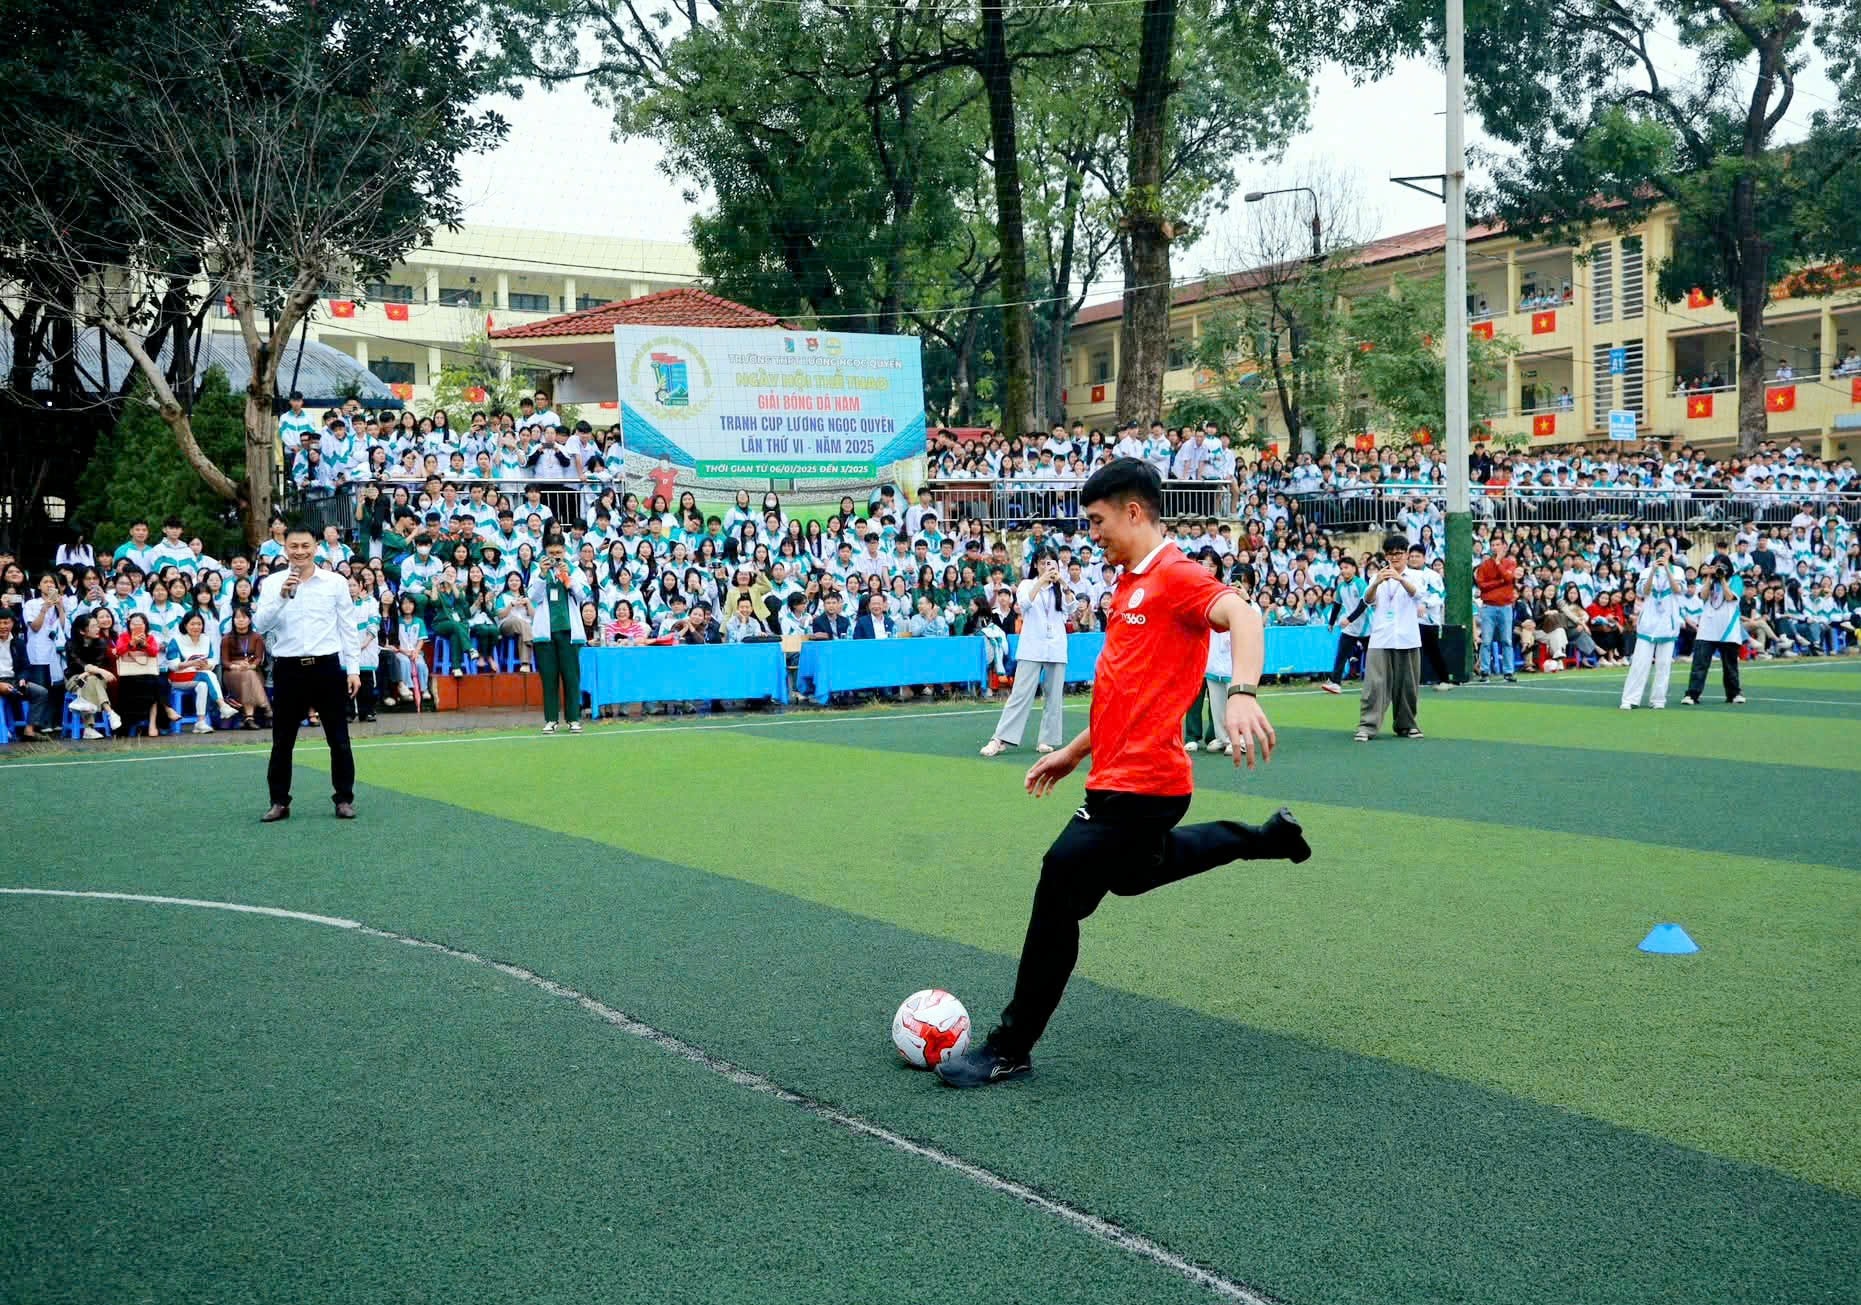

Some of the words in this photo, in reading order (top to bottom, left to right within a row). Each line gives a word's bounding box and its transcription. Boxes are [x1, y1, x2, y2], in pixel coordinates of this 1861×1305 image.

[758, 390, 779, 410] GIẢI
[784, 391, 813, 410] BÓNG
[835, 396, 861, 412] NAM
[720, 415, 758, 431] TRANH
[761, 416, 783, 431] CUP
[787, 415, 825, 433] LƯƠNG
[828, 417, 857, 436] NGỌC
[766, 435, 789, 453] THỨ
[793, 438, 804, 454] VI
[816, 435, 842, 454] NĂM
[845, 439, 875, 454] 2025
[706, 463, 728, 473] THỜI
[731, 465, 753, 473] GIAN
[756, 463, 768, 473] TỪ
[769, 465, 817, 474] 06/01/2025
[819, 463, 839, 473] ĐẾN
[840, 464, 869, 474] 3/2025
